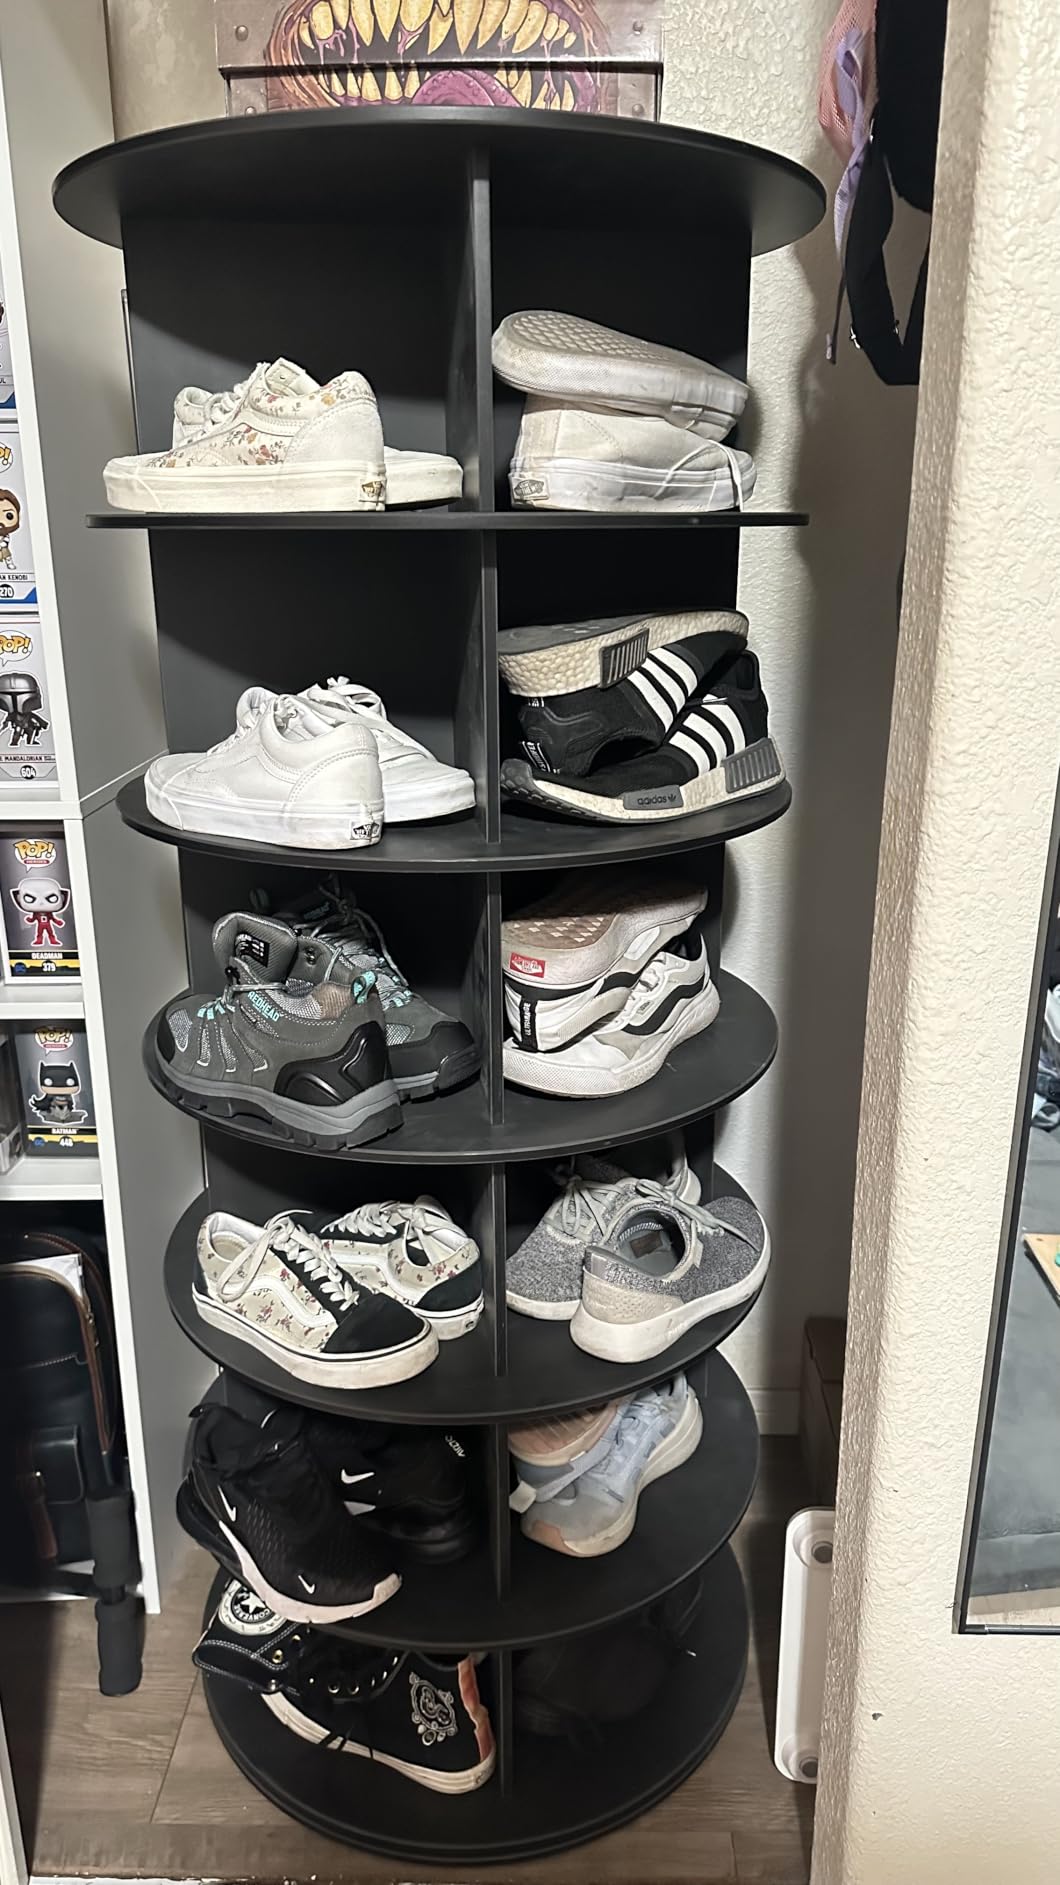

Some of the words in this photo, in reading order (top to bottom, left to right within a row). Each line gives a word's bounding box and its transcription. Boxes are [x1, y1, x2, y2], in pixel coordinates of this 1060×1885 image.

[637, 794, 667, 806] adidas
[13, 840, 55, 860] POP!
[31, 952, 64, 960] DEADMAN
[247, 990, 280, 1022] REDHEAD
[233, 1603, 271, 1622] CONVERSE
